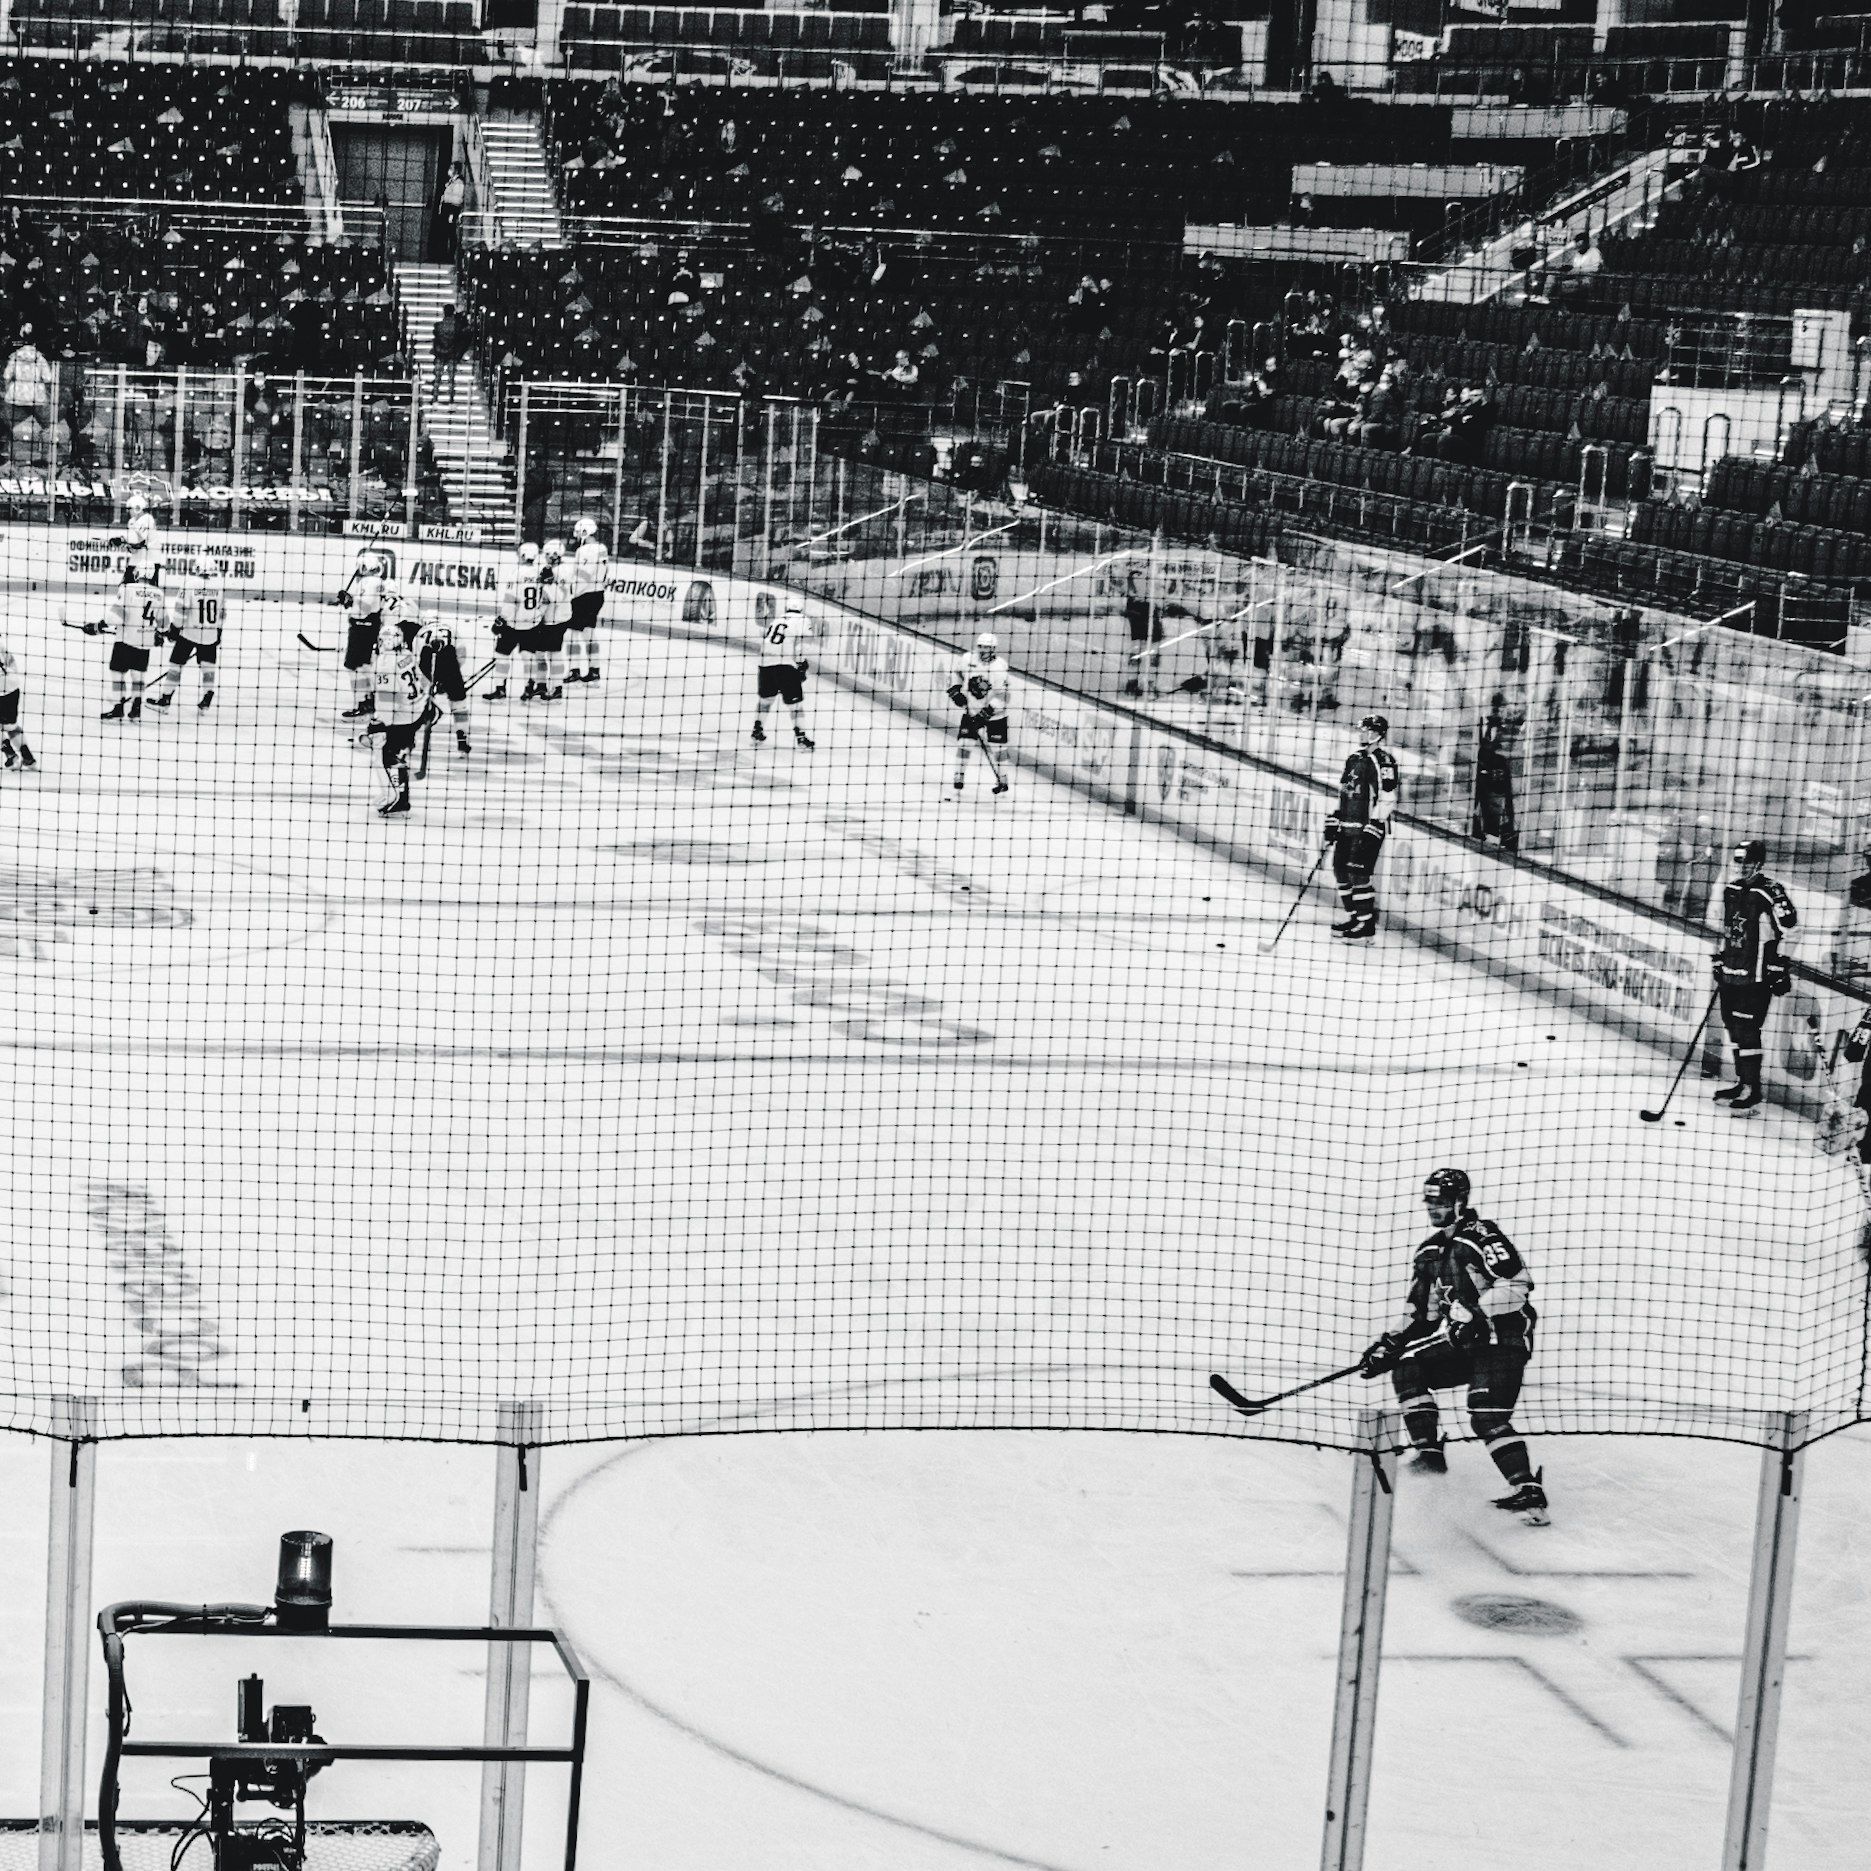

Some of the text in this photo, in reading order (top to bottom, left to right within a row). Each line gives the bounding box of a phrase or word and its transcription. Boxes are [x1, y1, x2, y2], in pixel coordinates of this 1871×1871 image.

[341, 96, 421, 110] 206 207
[351, 523, 399, 535] KHL.RU
[427, 528, 473, 541] KHL.RU
[409, 562, 496, 590] /HCCSKA
[142, 601, 155, 626] 4
[198, 599, 216, 624] 10
